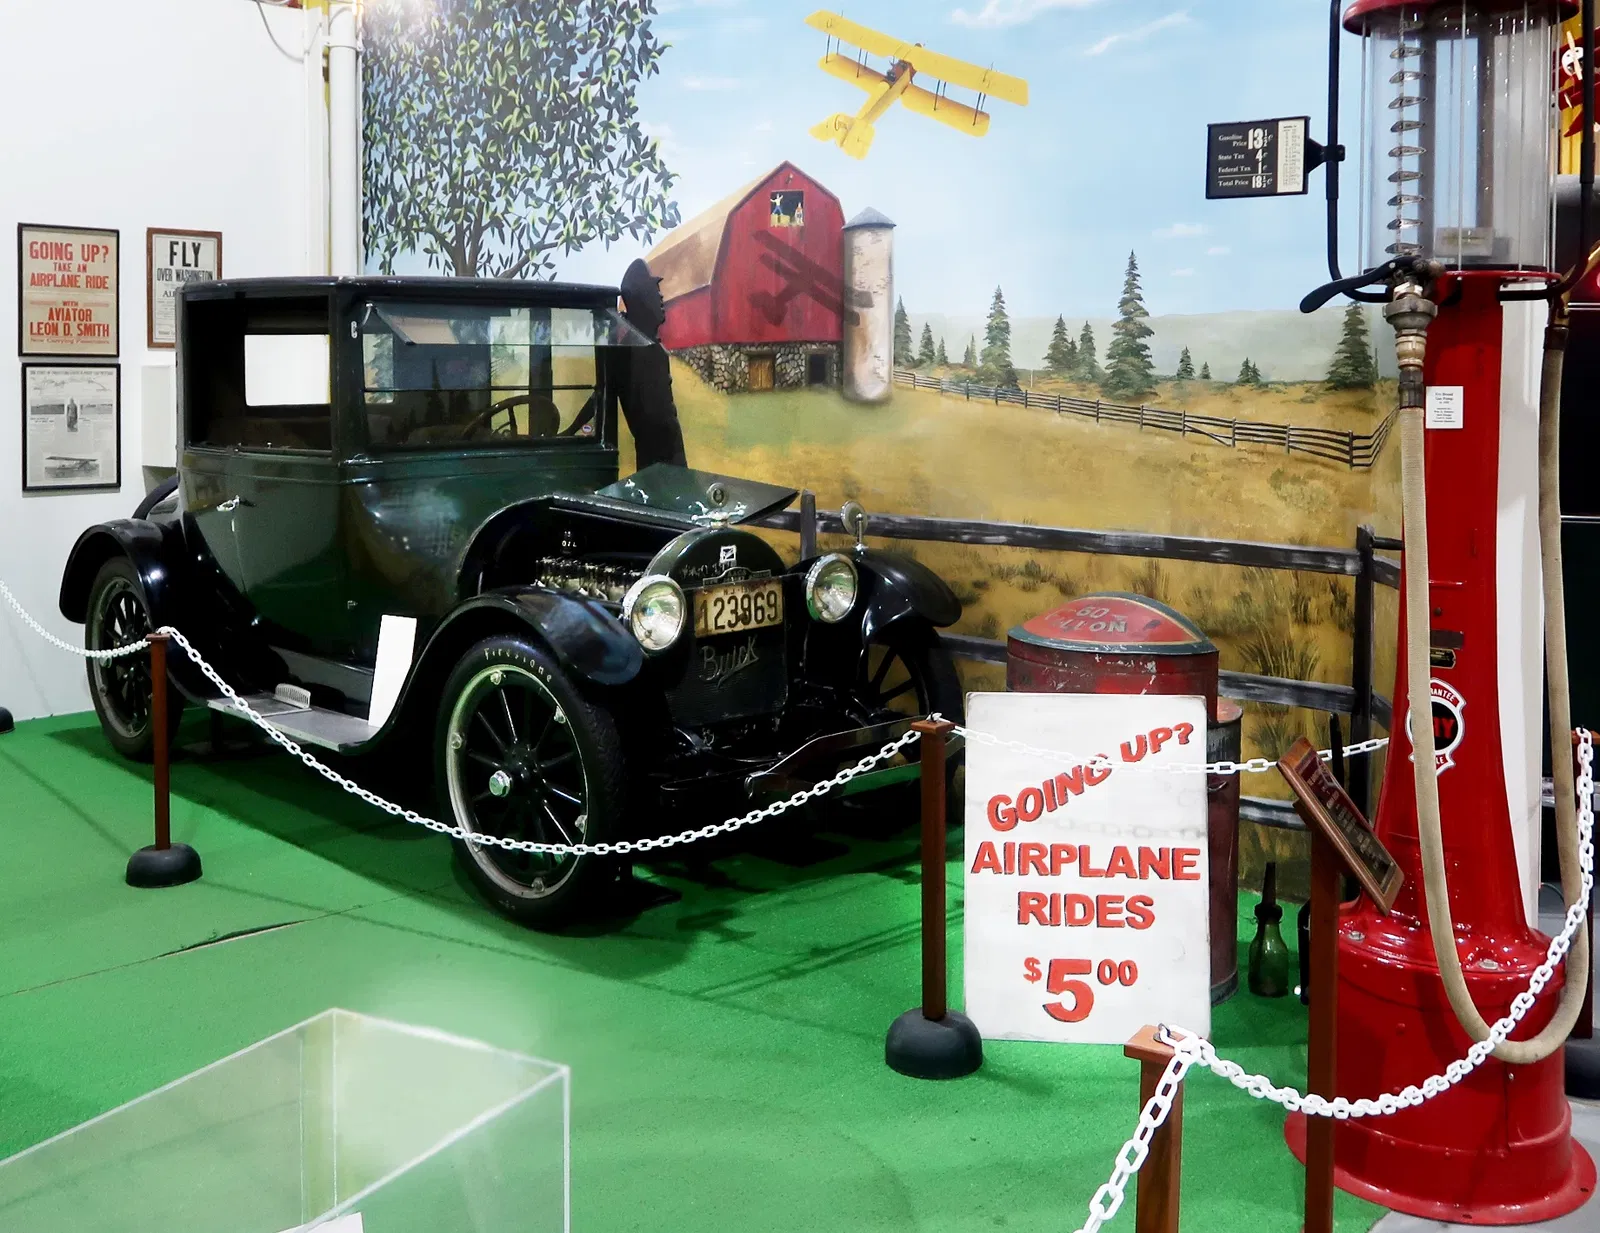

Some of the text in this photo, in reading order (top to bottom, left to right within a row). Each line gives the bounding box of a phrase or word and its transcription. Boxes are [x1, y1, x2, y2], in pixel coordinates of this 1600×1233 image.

[1233, 152, 1245, 160] Tax
[29, 241, 109, 263] GOING UP?
[169, 241, 201, 268] FLY
[53, 262, 87, 273] TAKE AN
[157, 268, 172, 282] OVER
[30, 272, 109, 289] AIRPLANE RIDE
[48, 307, 92, 322] AVIATOR
[30, 322, 109, 337] LEON D. SMITH
[699, 635, 760, 688] Buick
[987, 721, 1194, 832] GOING UP?
[971, 840, 1201, 881] AIRPLANE
[1017, 891, 1156, 930] RIDES
